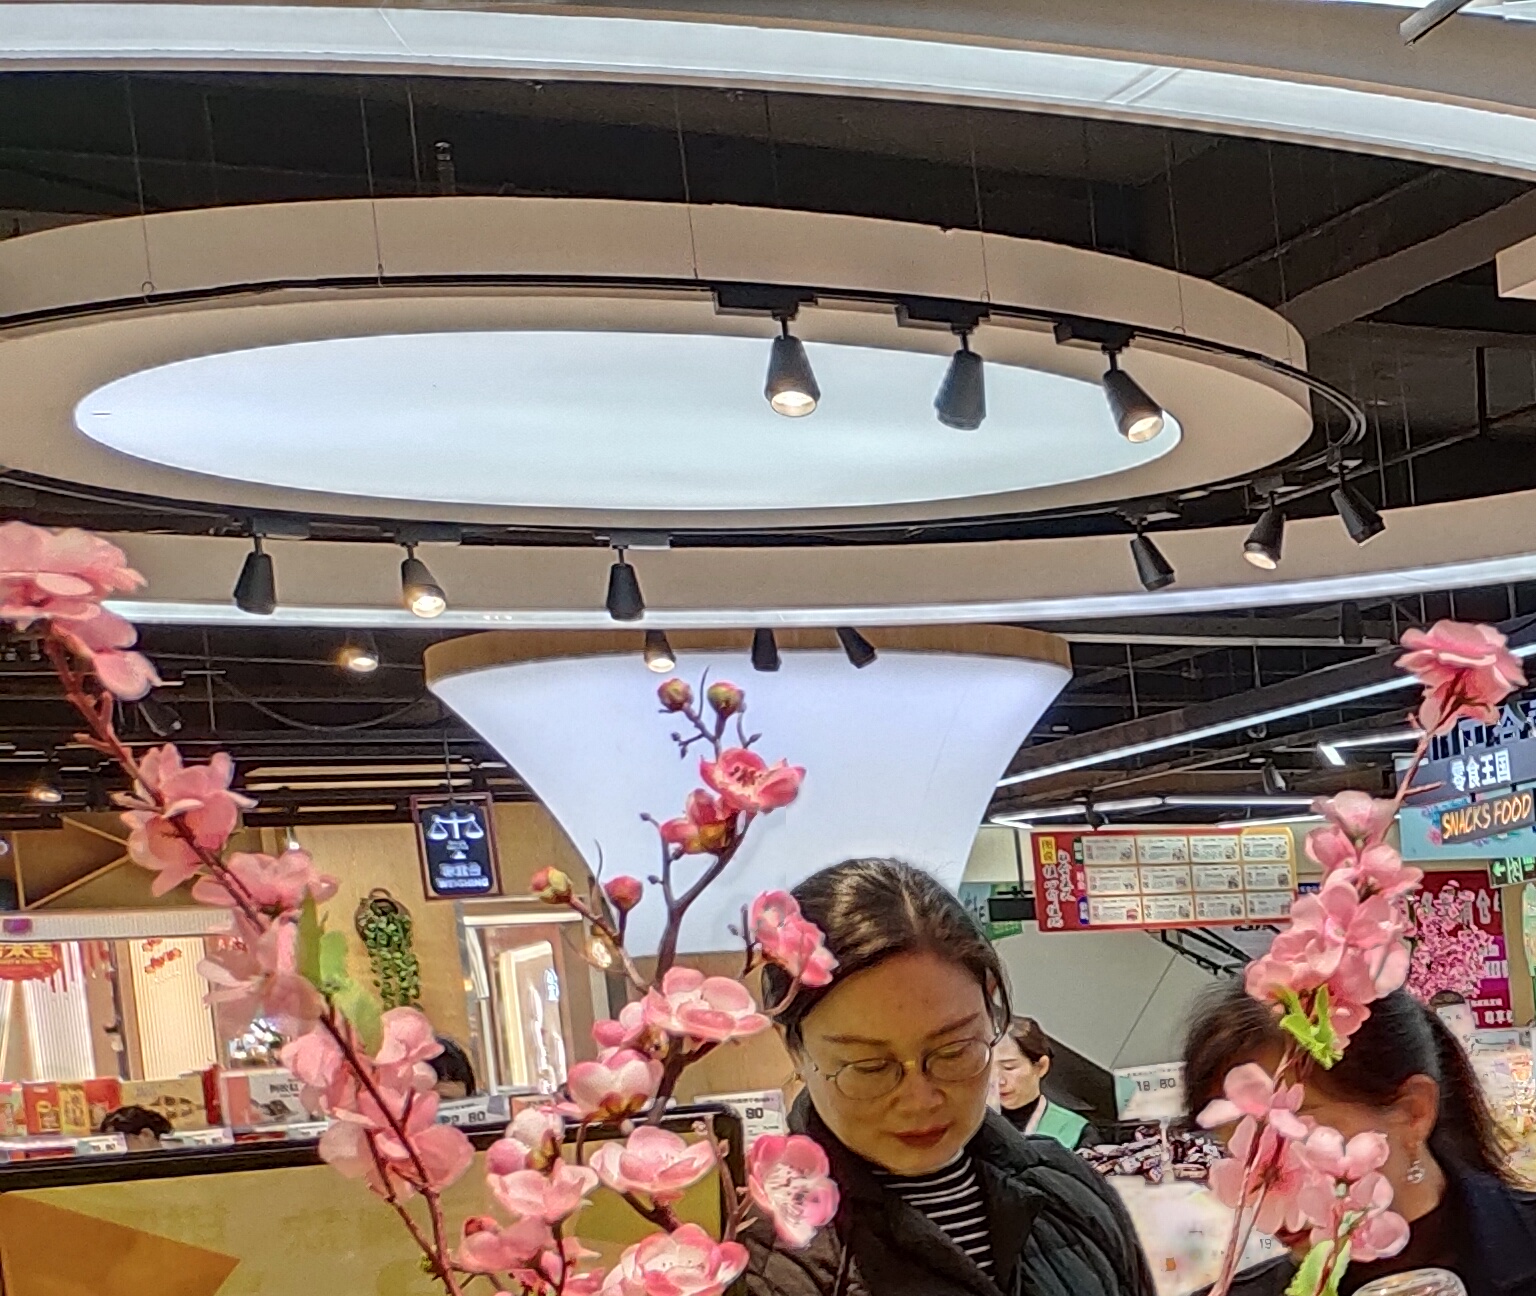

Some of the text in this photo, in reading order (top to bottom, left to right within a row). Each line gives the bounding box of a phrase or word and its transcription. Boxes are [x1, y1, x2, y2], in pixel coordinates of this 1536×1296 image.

[1451, 748, 1512, 792] 零食王国
[1441, 794, 1532, 840] SNACKS FOOD
